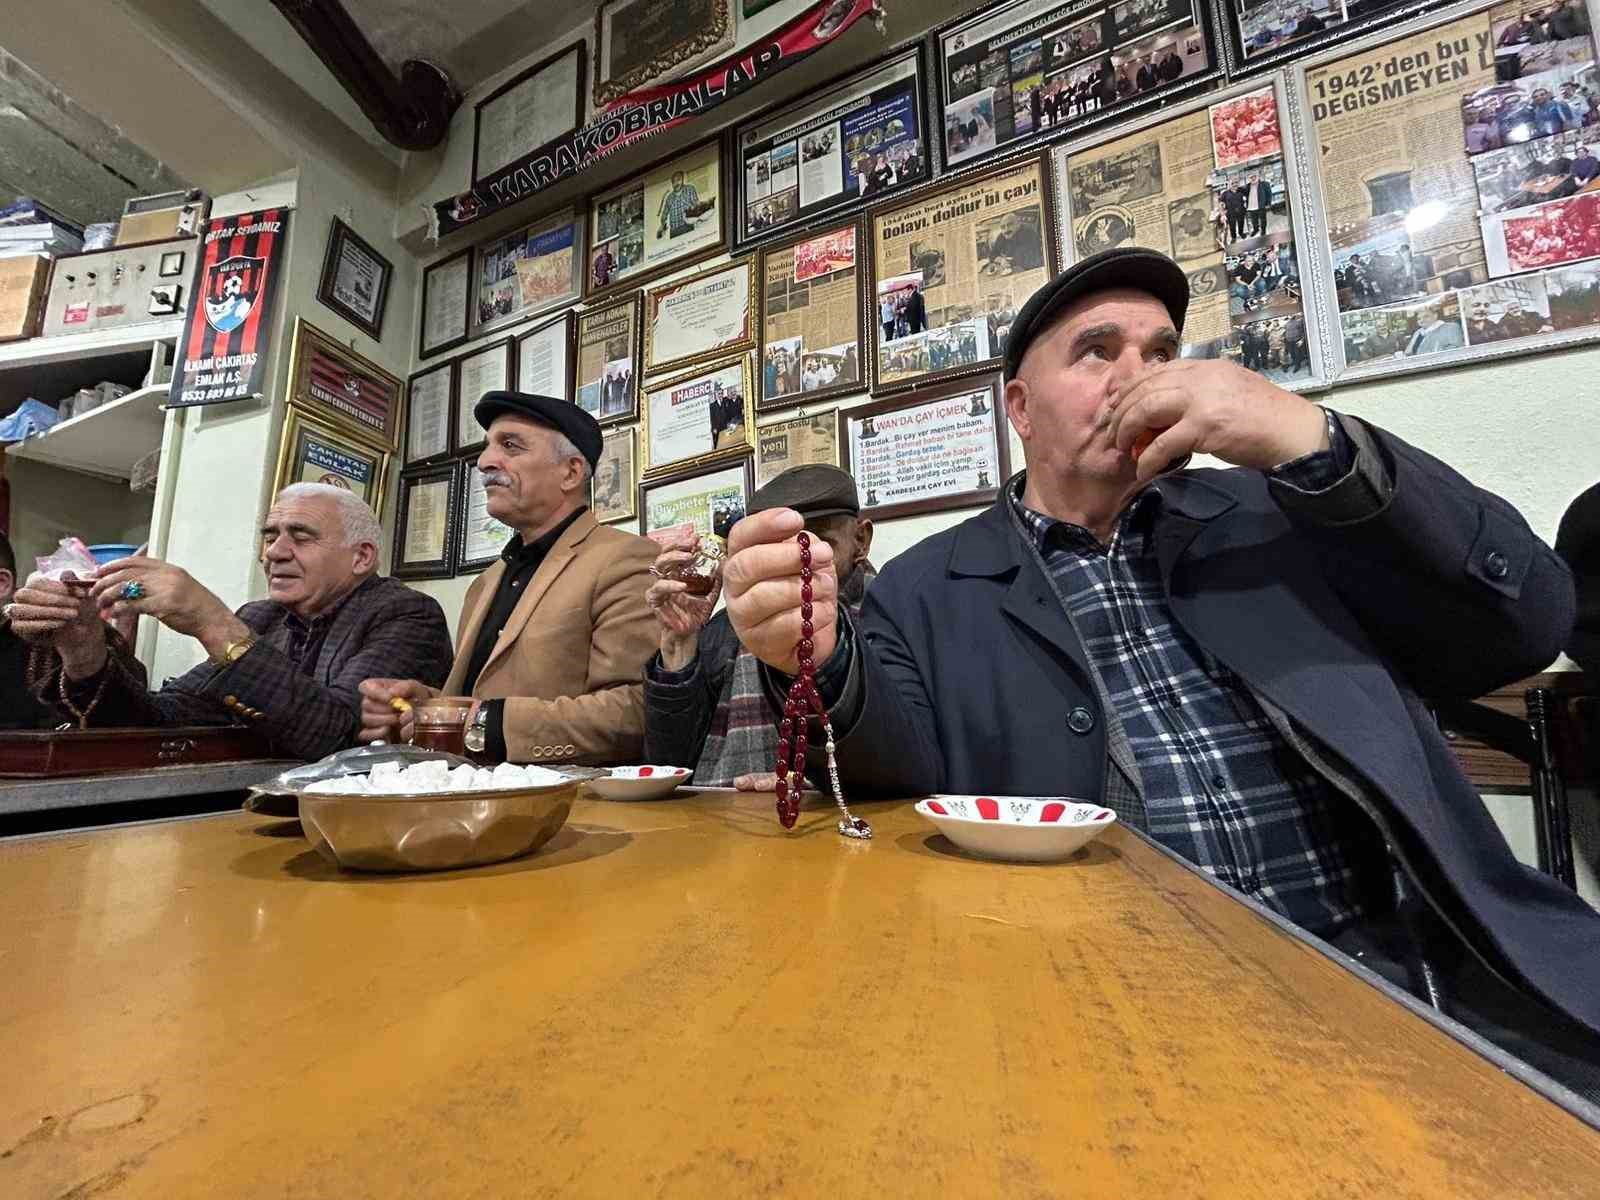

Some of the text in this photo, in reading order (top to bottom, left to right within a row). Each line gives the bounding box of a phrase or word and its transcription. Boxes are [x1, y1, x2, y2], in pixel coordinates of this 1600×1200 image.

[1314, 51, 1430, 99] 1942'den
[1436, 38, 1469, 61] bu
[932, 202, 982, 225] doldur
[1004, 178, 1038, 202] çay!
[194, 372, 226, 386] EMLAK
[915, 411, 935, 425] ÇAY
[761, 437, 786, 455] yeni
[307, 451, 364, 478] EMLAK
[927, 481, 943, 491] ÇAY
